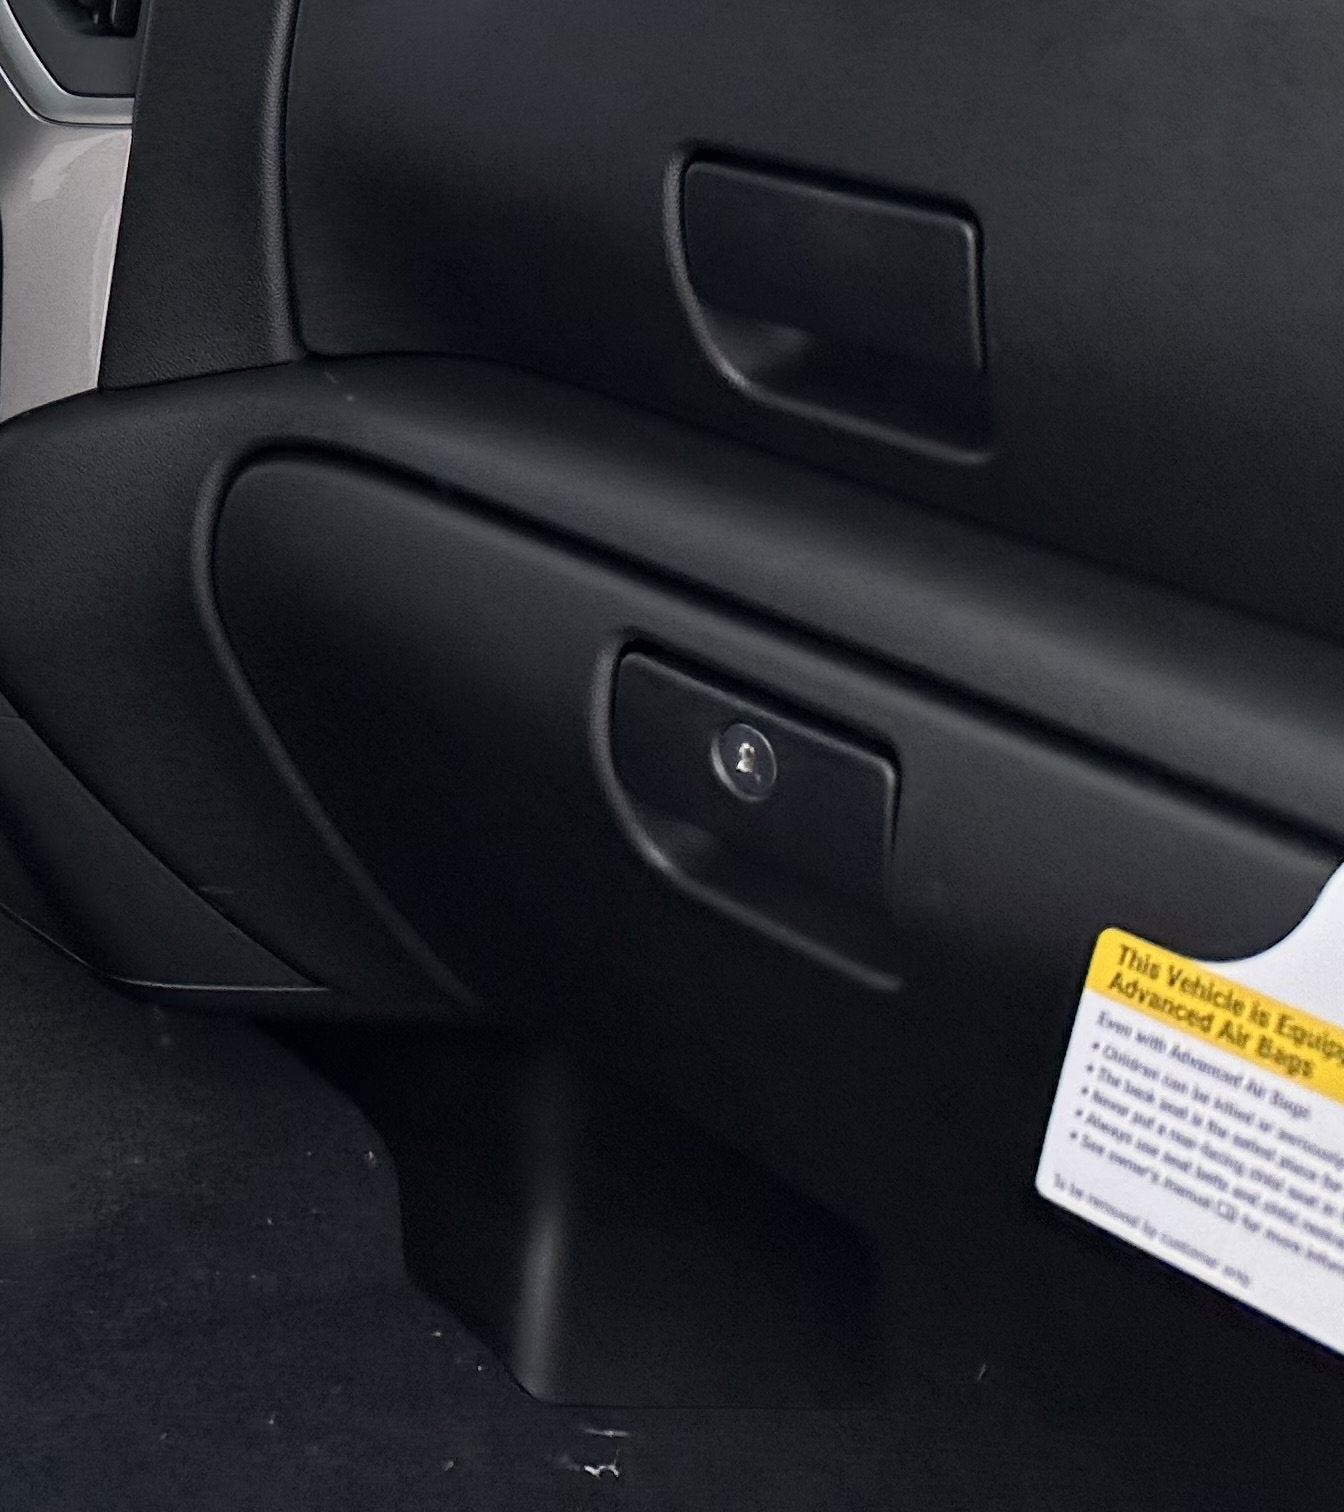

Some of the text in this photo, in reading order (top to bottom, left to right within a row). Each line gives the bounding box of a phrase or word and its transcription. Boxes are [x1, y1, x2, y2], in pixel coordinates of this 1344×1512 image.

[1108, 972, 1315, 1077] Advanced Air Bags
[1118, 944, 1161, 980] This
[1168, 965, 1246, 1017] Vehicle
[1248, 1000, 1272, 1028] is
